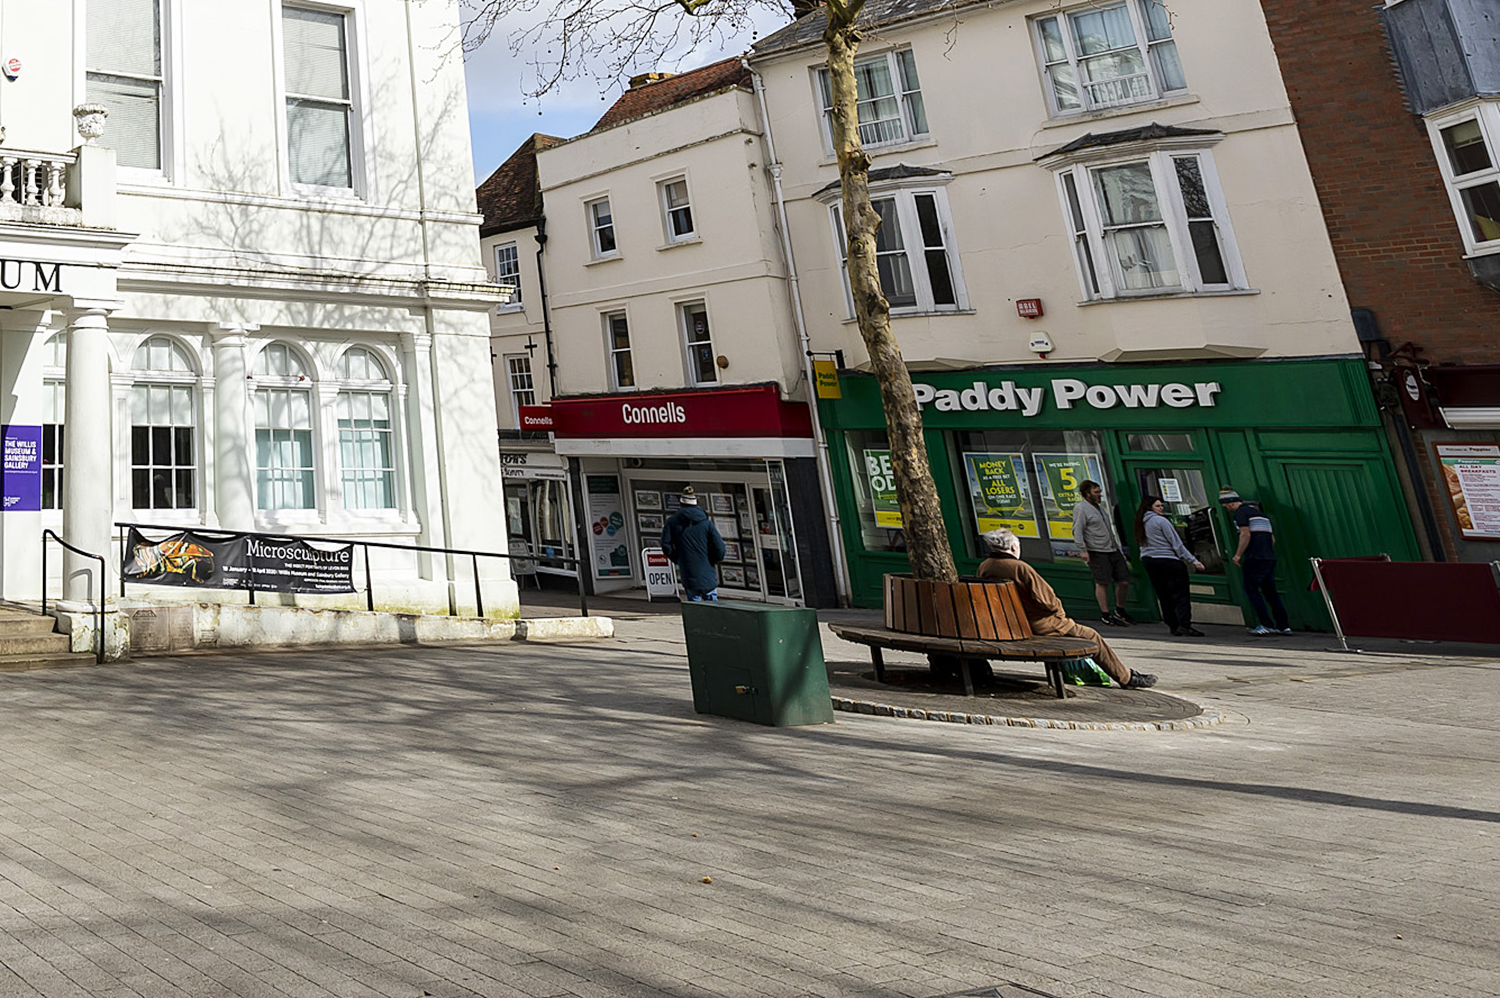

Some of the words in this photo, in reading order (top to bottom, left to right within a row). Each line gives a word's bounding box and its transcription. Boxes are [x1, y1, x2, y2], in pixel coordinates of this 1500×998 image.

[818, 372, 836, 381] Paddy
[911, 380, 1044, 417] Paddy
[1051, 379, 1222, 410] Power
[622, 402, 686, 424] Connells
[524, 416, 553, 425] Connells
[16, 440, 37, 448] WILLIS
[4, 447, 31, 455] MUSEUM
[4, 454, 38, 462] SAINSBURY
[866, 455, 894, 476] BE
[979, 460, 1007, 469] MONEY
[871, 475, 897, 492] OD
[1060, 468, 1078, 491] 5
[985, 486, 1015, 495] LOSERS
[649, 572, 672, 585] OPEN
